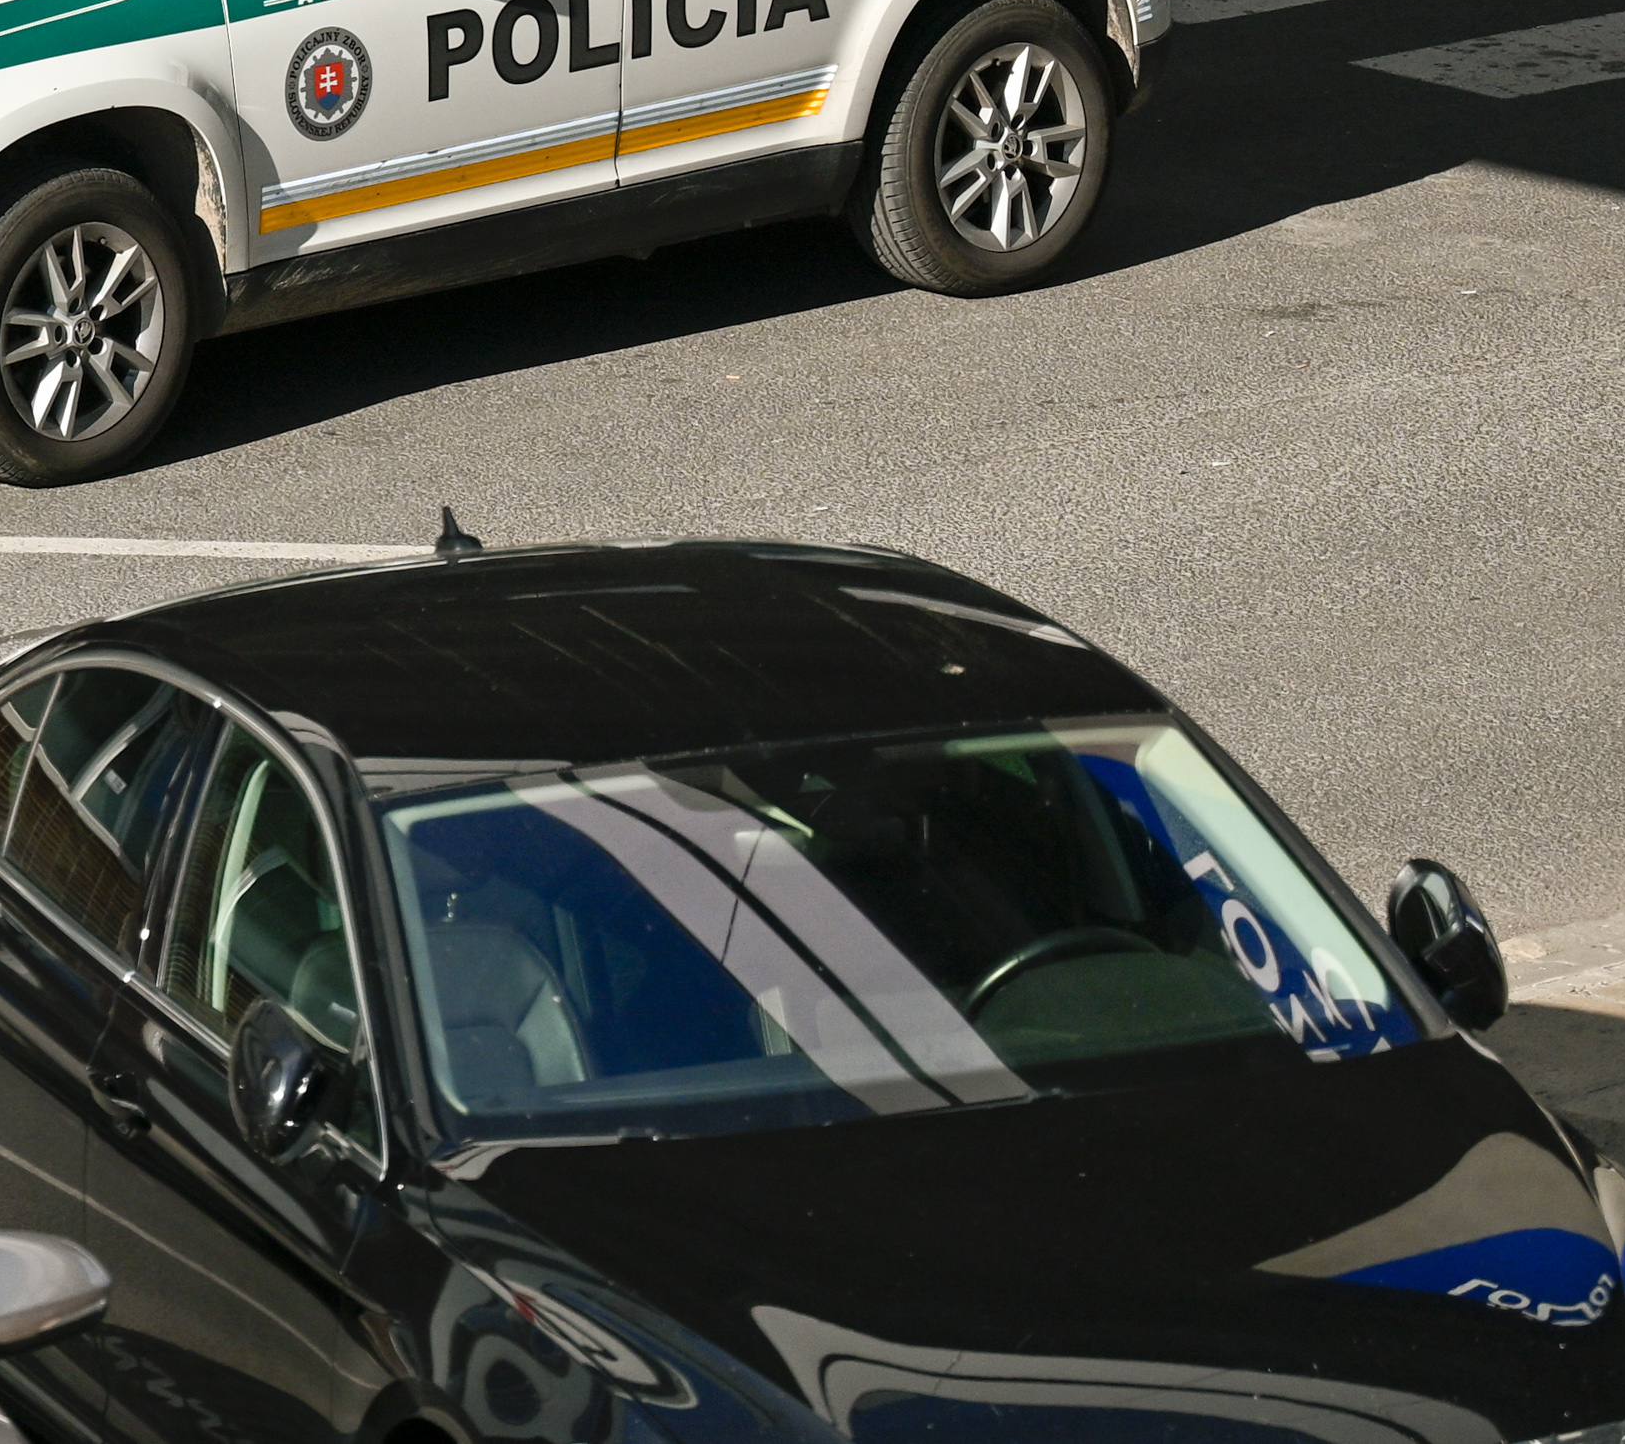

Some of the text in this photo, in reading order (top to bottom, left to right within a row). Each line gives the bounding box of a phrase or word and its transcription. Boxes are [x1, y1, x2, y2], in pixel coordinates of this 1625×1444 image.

[290, 28, 367, 79] POLICAJNÝ ZBOR
[287, 74, 370, 136] SLOVENSKEJ REPUBLIKY
